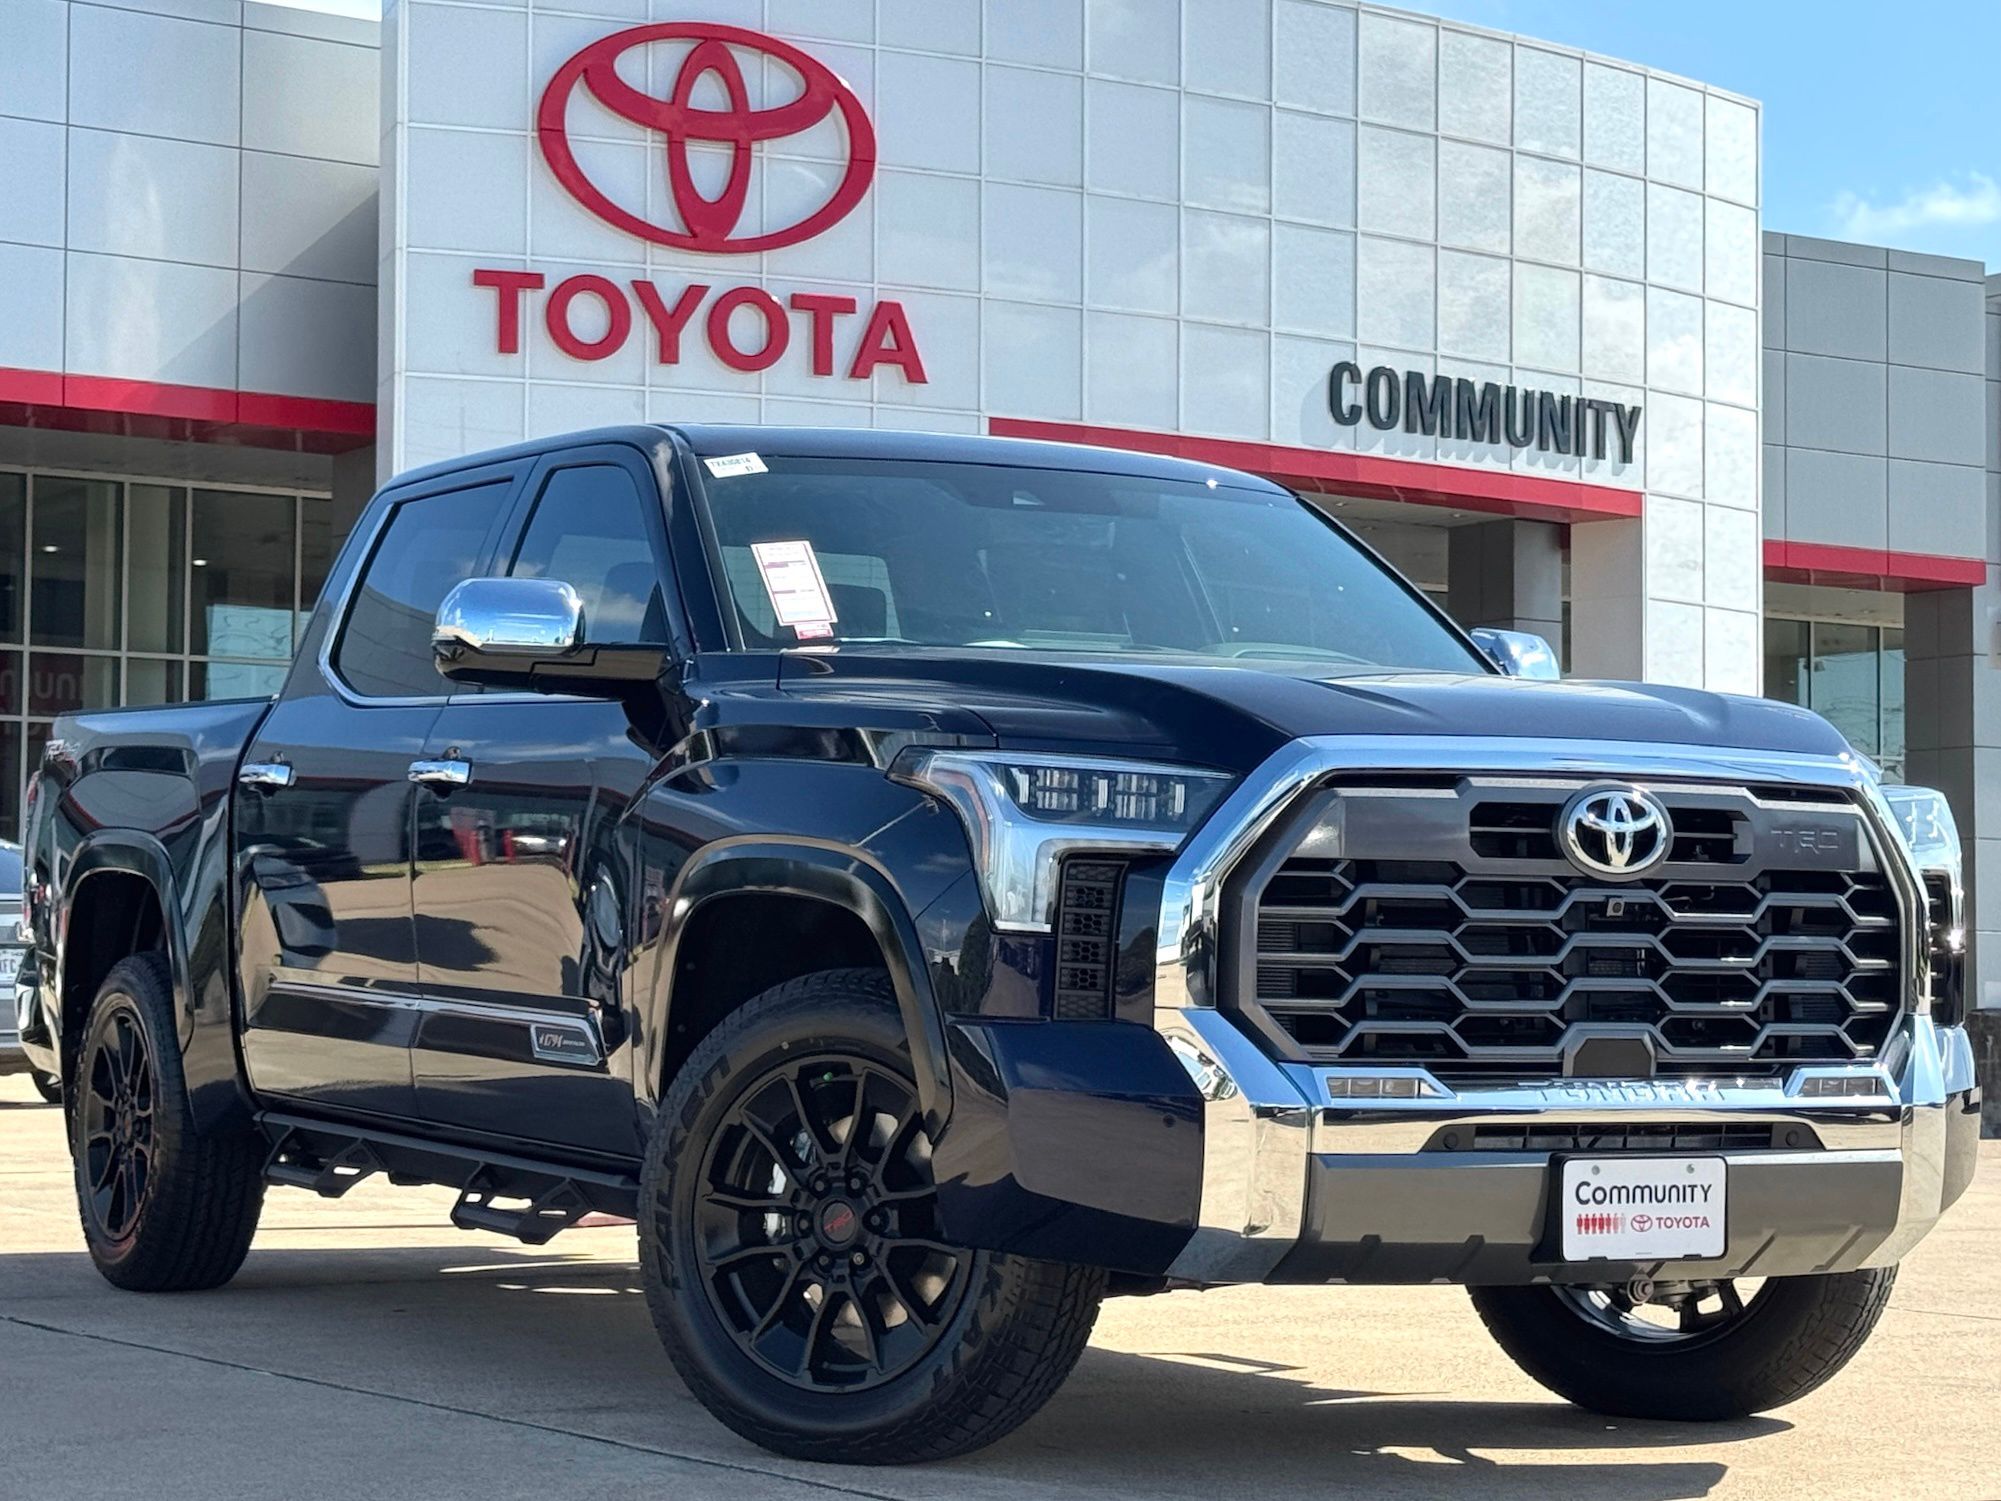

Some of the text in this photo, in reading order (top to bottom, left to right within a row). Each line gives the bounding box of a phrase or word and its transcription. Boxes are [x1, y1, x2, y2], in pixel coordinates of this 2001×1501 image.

[473, 269, 928, 384] TOYOTA
[1329, 360, 1642, 464] COMMUNITY
[1770, 829, 1840, 855] TRD
[1517, 1080, 1726, 1103] TUNDRA
[1655, 1215, 1711, 1230] TOYOTA
